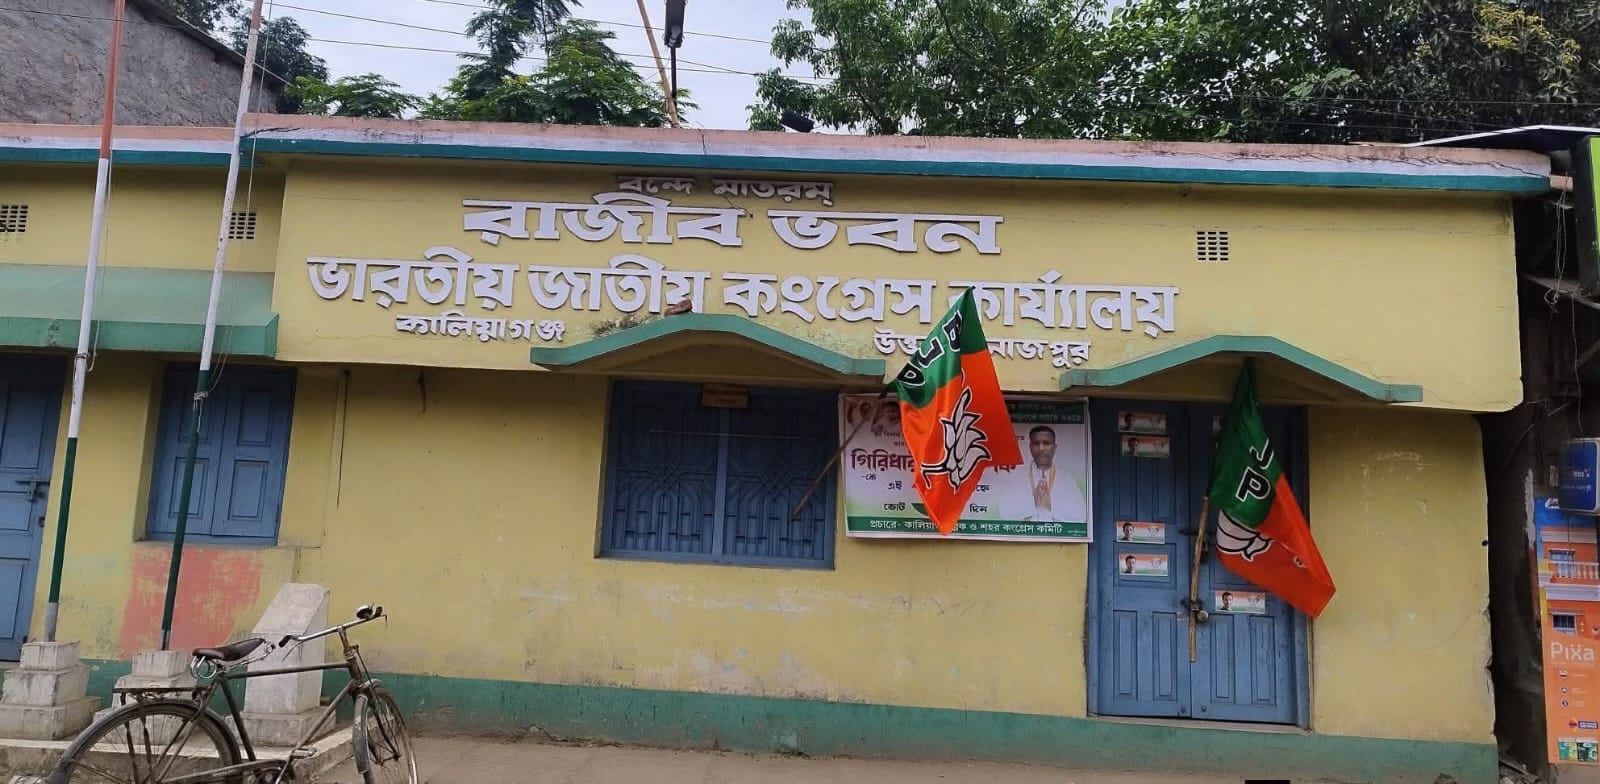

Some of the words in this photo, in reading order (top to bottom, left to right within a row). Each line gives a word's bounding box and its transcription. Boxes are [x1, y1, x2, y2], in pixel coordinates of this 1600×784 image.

[617, 176, 695, 195] বন্দে
[712, 179, 833, 206] মাতরম্
[463, 192, 745, 247] রাজীব
[768, 210, 1004, 254] ভবন
[306, 246, 519, 309] ভারতীয়
[528, 254, 711, 314] জাতীয়
[723, 272, 936, 323] কংগ্রেস
[873, 328, 927, 356] উত্ত
